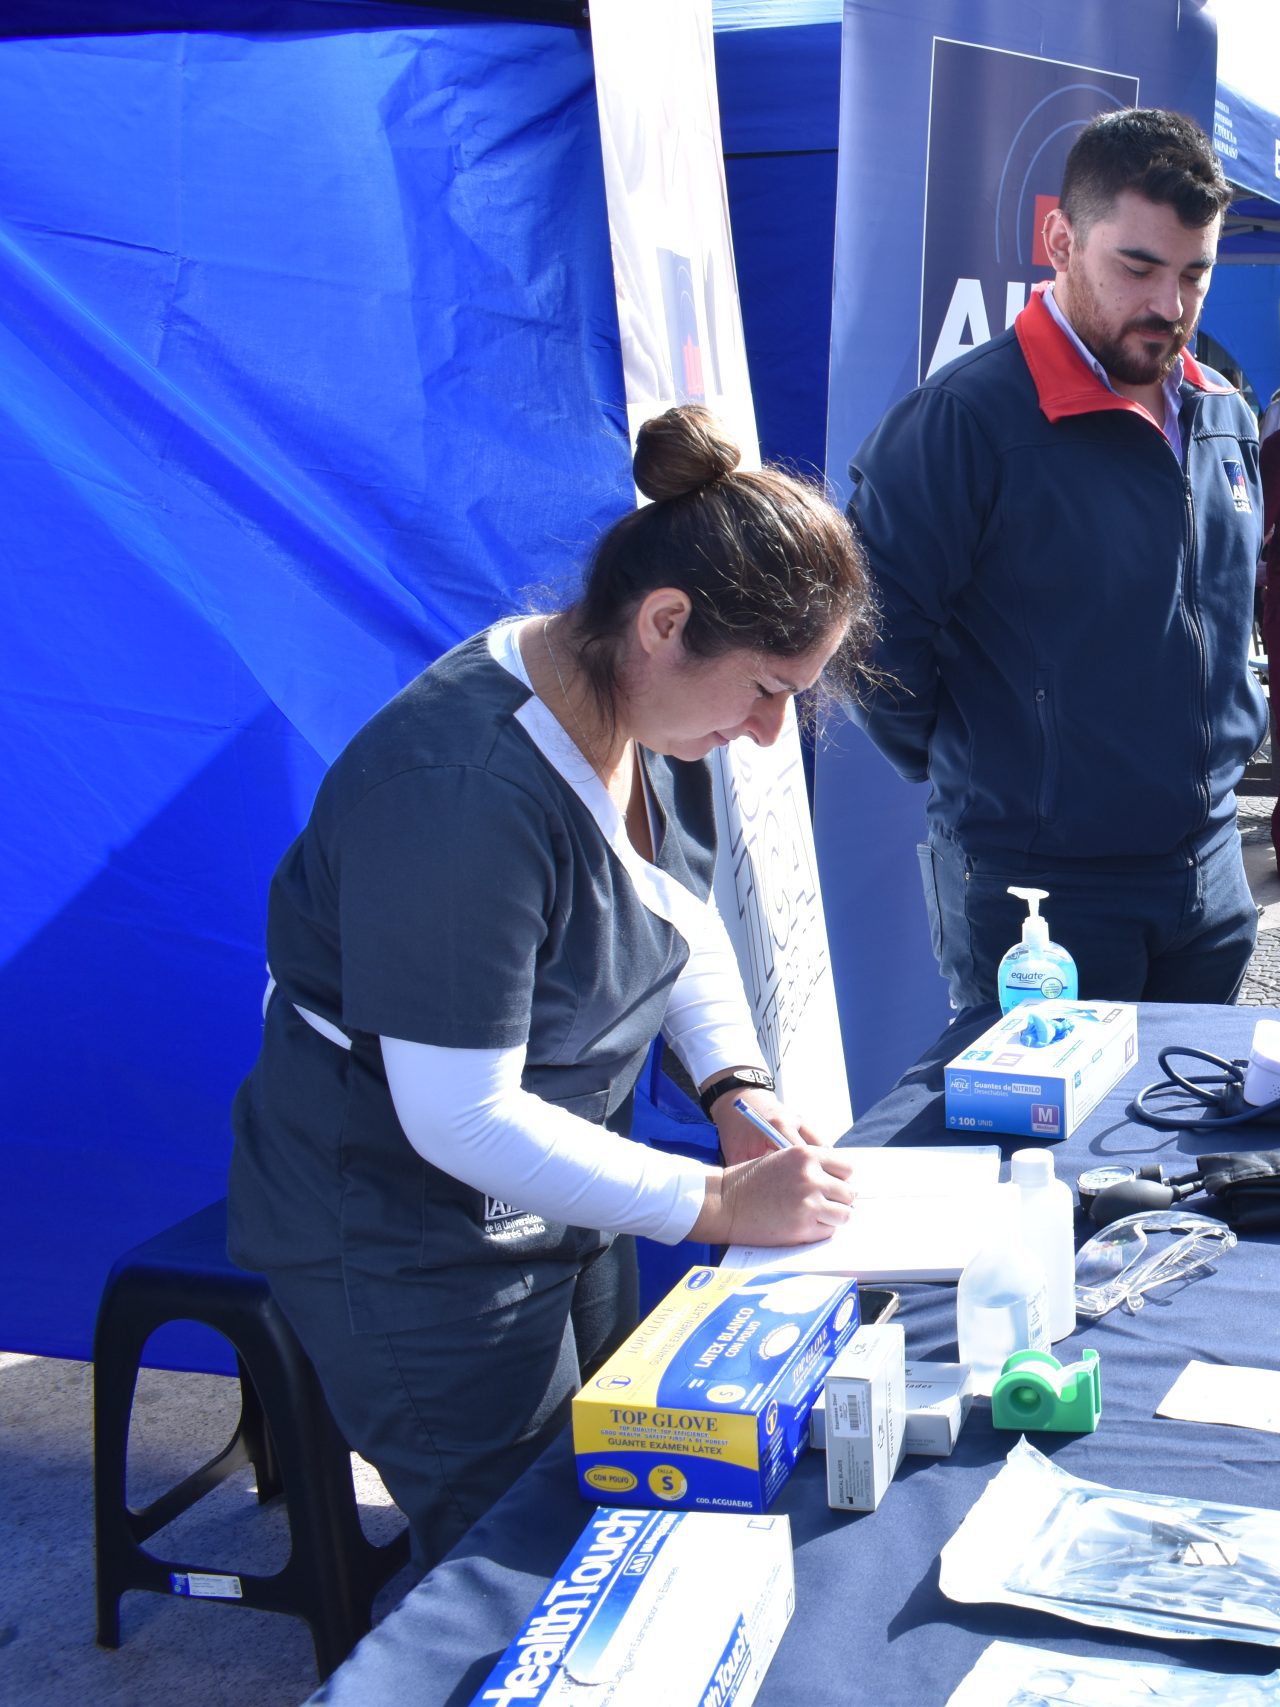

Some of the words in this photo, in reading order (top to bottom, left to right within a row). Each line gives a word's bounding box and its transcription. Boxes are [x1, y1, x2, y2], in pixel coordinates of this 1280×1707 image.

[1011, 972, 1043, 982] equate
[974, 1082, 1002, 1090] Guantes
[1013, 1085, 1040, 1094] NITRILO
[974, 1088, 1008, 1097] Desechables
[958, 1117, 976, 1126] 100
[1038, 1108, 1052, 1123] M
[485, 1222, 494, 1233] de
[494, 1222, 502, 1230] la
[490, 1228, 522, 1240] Andrés
[523, 1224, 546, 1236] Bello
[625, 1335, 648, 1355] TOP
[645, 1306, 675, 1336] GLOVE
[694, 1341, 727, 1368] LATEX
[717, 1307, 755, 1342] BLANCO
[724, 1342, 745, 1358] CON
[738, 1320, 761, 1342] POLVO
[804, 1326, 828, 1365] GLOVE
[648, 1340, 675, 1366] GUANTE
[610, 1409, 647, 1426] TOP
[652, 1412, 718, 1432] GLOVE
[608, 1438, 646, 1448] GUANTE
[594, 1474, 607, 1482] CON
[608, 1475, 629, 1484] POLVO
[662, 1476, 674, 1491] S
[712, 1498, 753, 1508] ACGUAEMS
